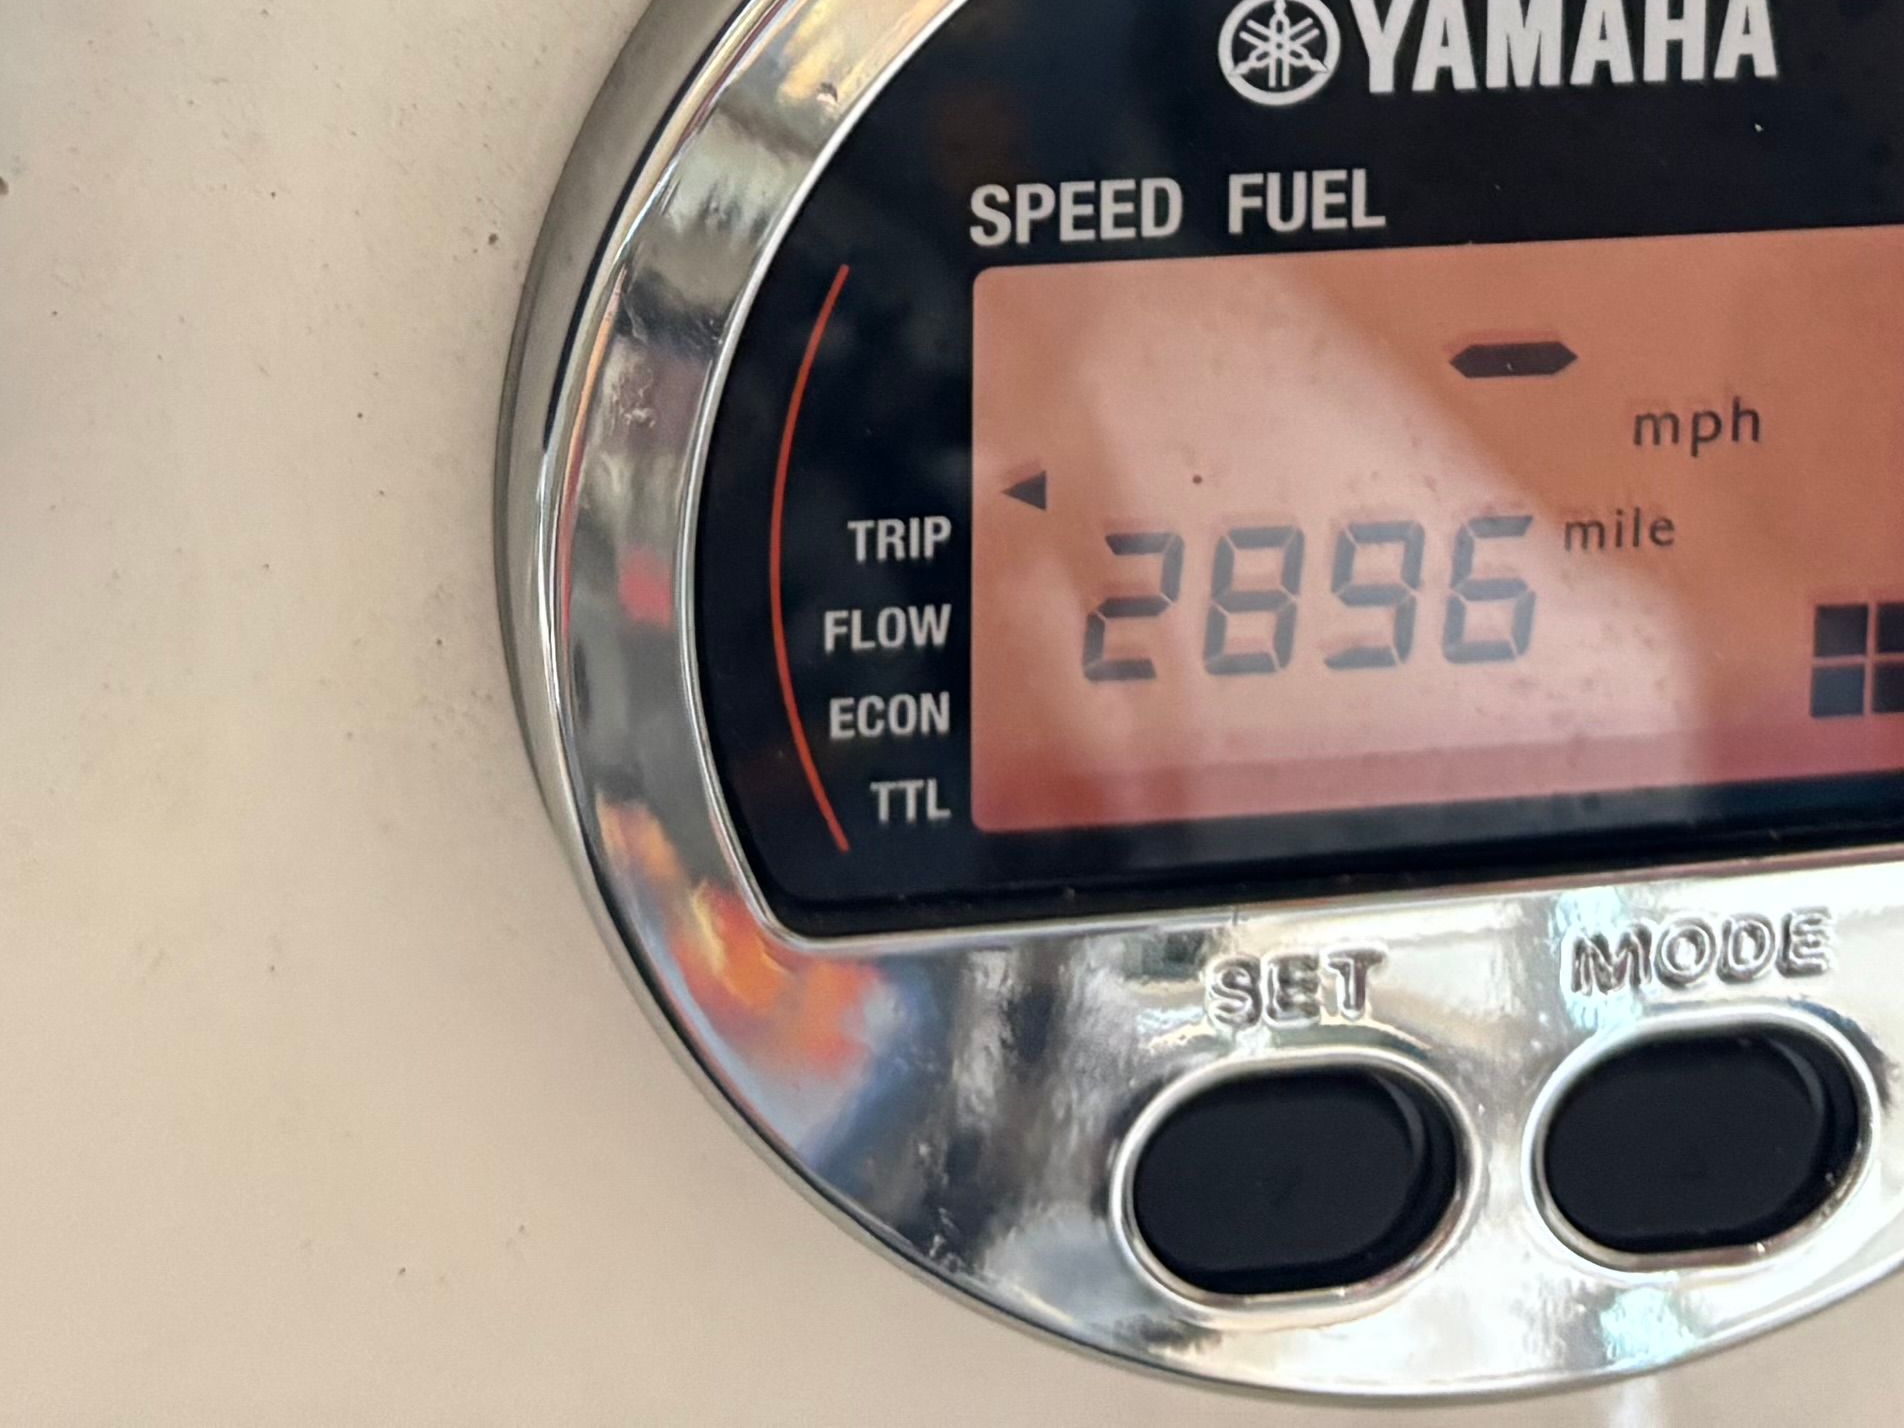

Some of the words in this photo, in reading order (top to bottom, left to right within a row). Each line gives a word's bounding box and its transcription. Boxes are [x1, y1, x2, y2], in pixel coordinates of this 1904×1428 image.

[968, 176, 1184, 248] SPEED
[1227, 168, 1387, 235] FUEL
[1632, 396, 1762, 457] mph
[847, 514, 952, 564] TRIP
[1081, 514, 1537, 684] 2896
[1563, 505, 1676, 553] mile
[823, 602, 952, 654] FLOW
[828, 690, 951, 741] ECON
[869, 777, 952, 824] TTL
[1204, 949, 1388, 1028] SET
[1571, 906, 1834, 999] MODE
